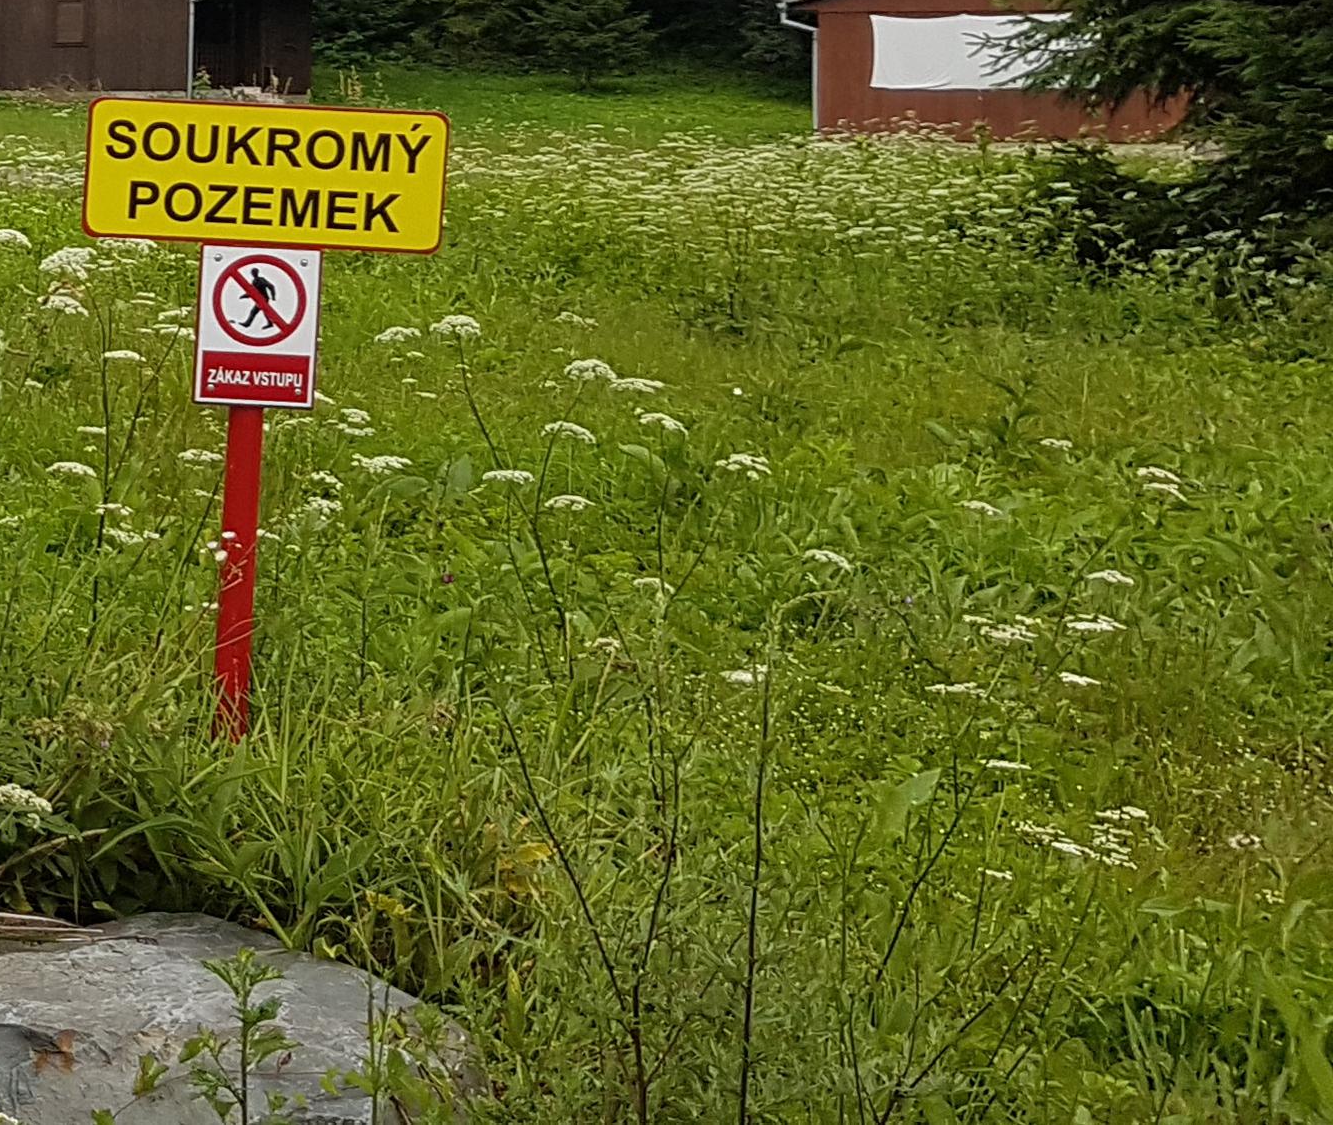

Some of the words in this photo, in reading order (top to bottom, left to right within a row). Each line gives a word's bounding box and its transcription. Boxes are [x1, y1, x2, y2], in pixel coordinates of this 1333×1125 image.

[105, 119, 432, 174] SOUKROMÝ
[128, 180, 401, 233] POZEMEK
[207, 365, 250, 385] ZÁKAZ
[252, 371, 303, 387] VSTUPU
